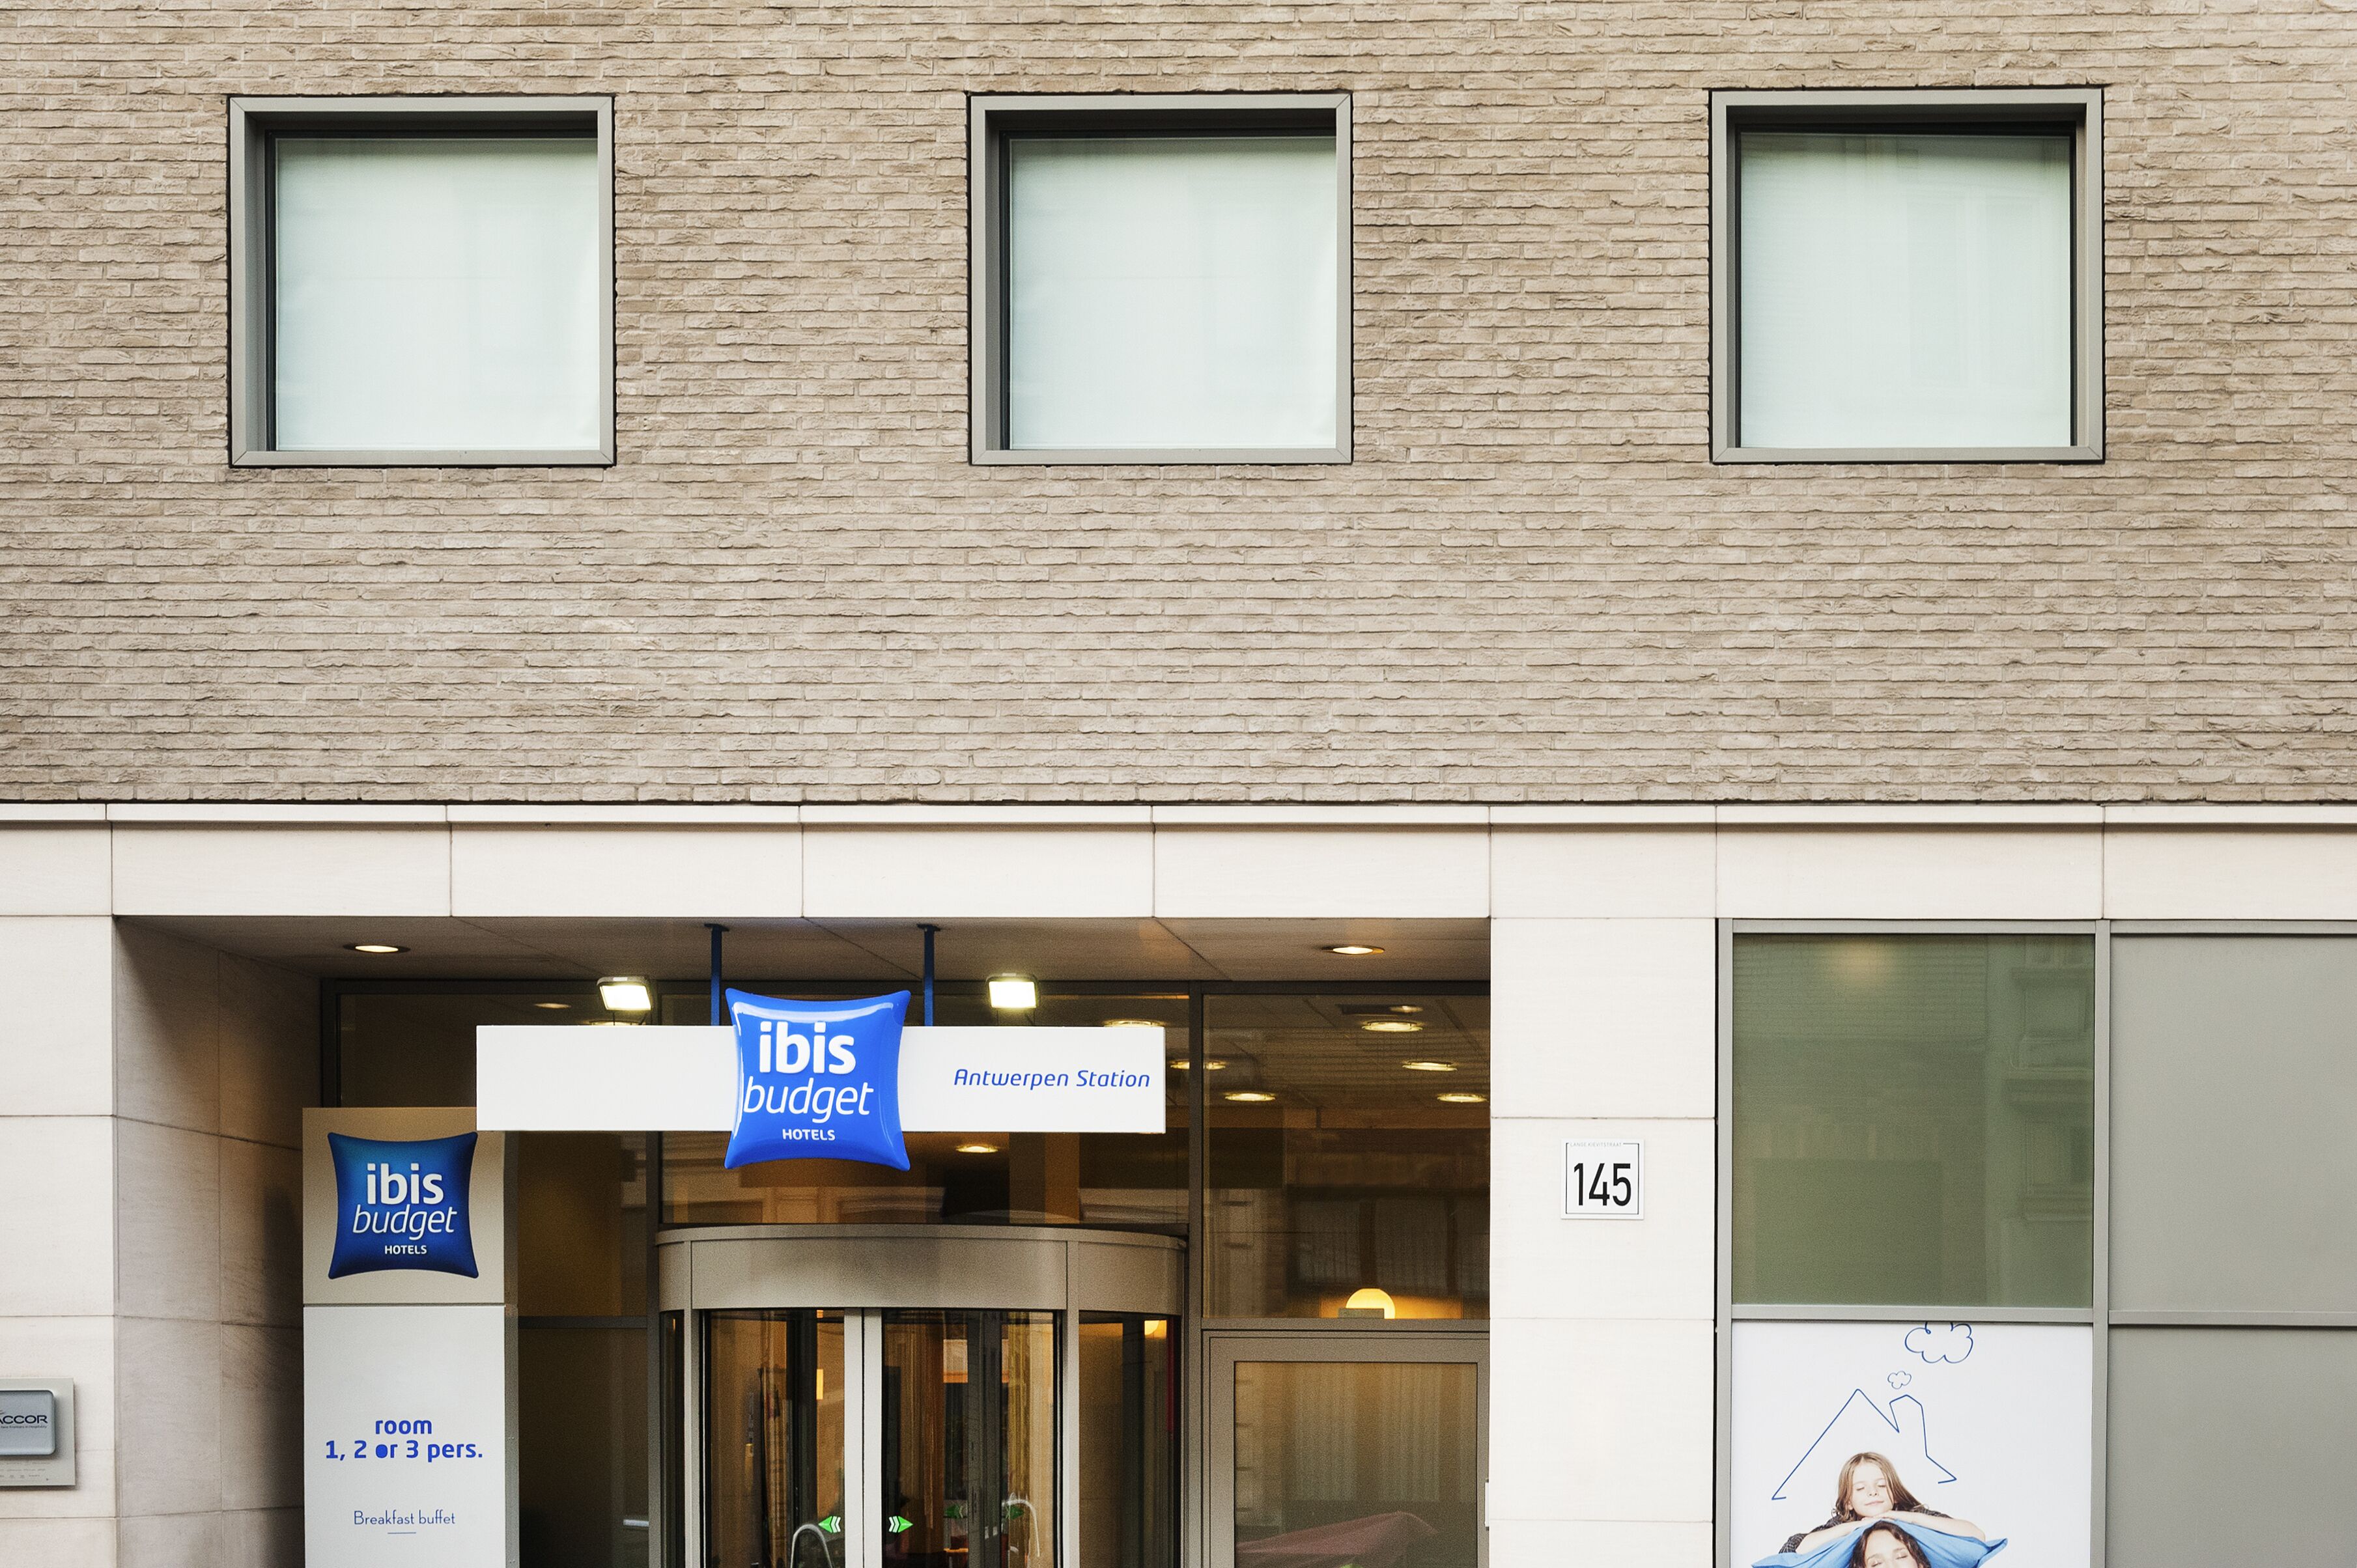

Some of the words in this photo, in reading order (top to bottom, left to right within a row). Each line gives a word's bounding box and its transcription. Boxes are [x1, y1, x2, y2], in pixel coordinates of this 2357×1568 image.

[759, 1021, 856, 1074] ibis
[954, 1069, 1069, 1090] Antwerpen
[1076, 1070, 1150, 1087] Station
[743, 1076, 874, 1123] budget
[782, 1128, 836, 1141] HOTELS
[367, 1163, 444, 1205] ibis
[1574, 1163, 1631, 1206] 145
[352, 1204, 457, 1240] budget
[384, 1245, 427, 1254] HOTELS
[375, 1420, 432, 1435] room
[326, 1440, 345, 1461] 1,
[354, 1440, 367, 1459] 2
[375, 1444, 398, 1459] or
[406, 1440, 419, 1458] 3
[427, 1443, 483, 1463] pers.
[354, 1510, 415, 1525] Breakfast
[419, 1509, 455, 1524] buffet
